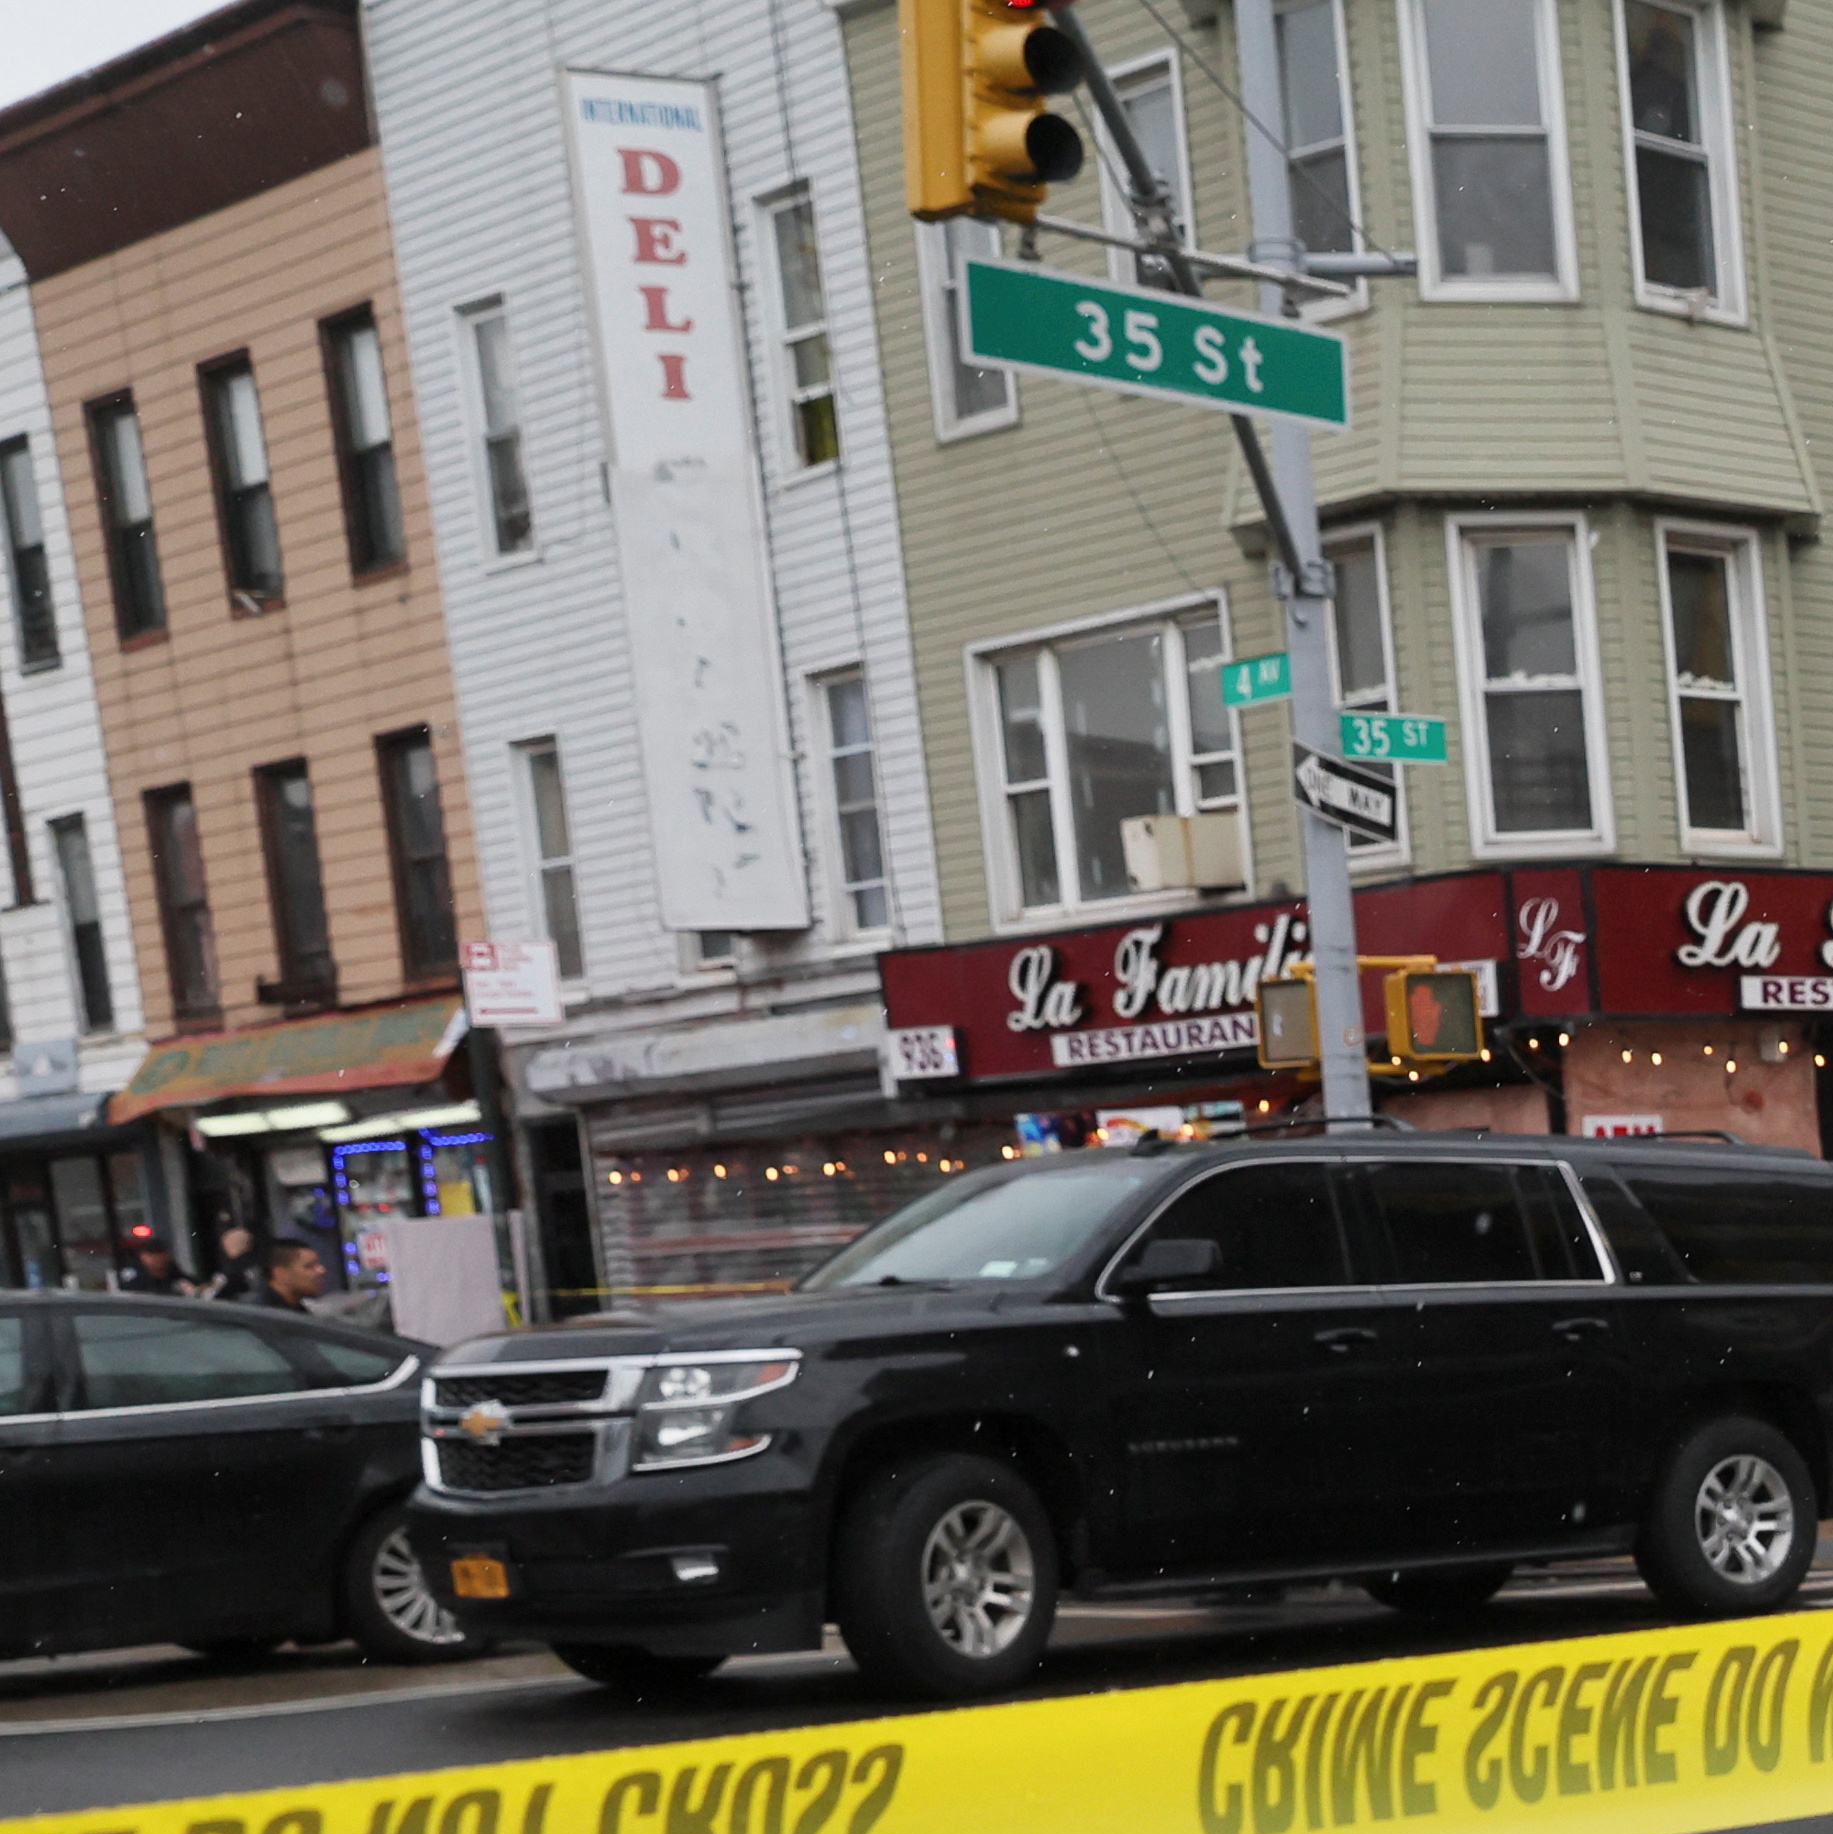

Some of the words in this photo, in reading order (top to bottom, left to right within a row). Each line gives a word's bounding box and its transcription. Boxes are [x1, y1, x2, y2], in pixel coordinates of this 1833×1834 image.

[617, 146, 694, 402] DELI
[1074, 300, 1163, 373] 35
[1192, 326, 1265, 394] St
[1236, 665, 1253, 699] 4
[1258, 657, 1281, 684] AV
[1352, 717, 1391, 755] 35
[1401, 720, 1430, 747] ST
[1348, 788, 1383, 812] WAY
[1677, 881, 1782, 968] La
[1007, 944, 1083, 1032] La
[1068, 1018, 1256, 1060] RESTAURAN
